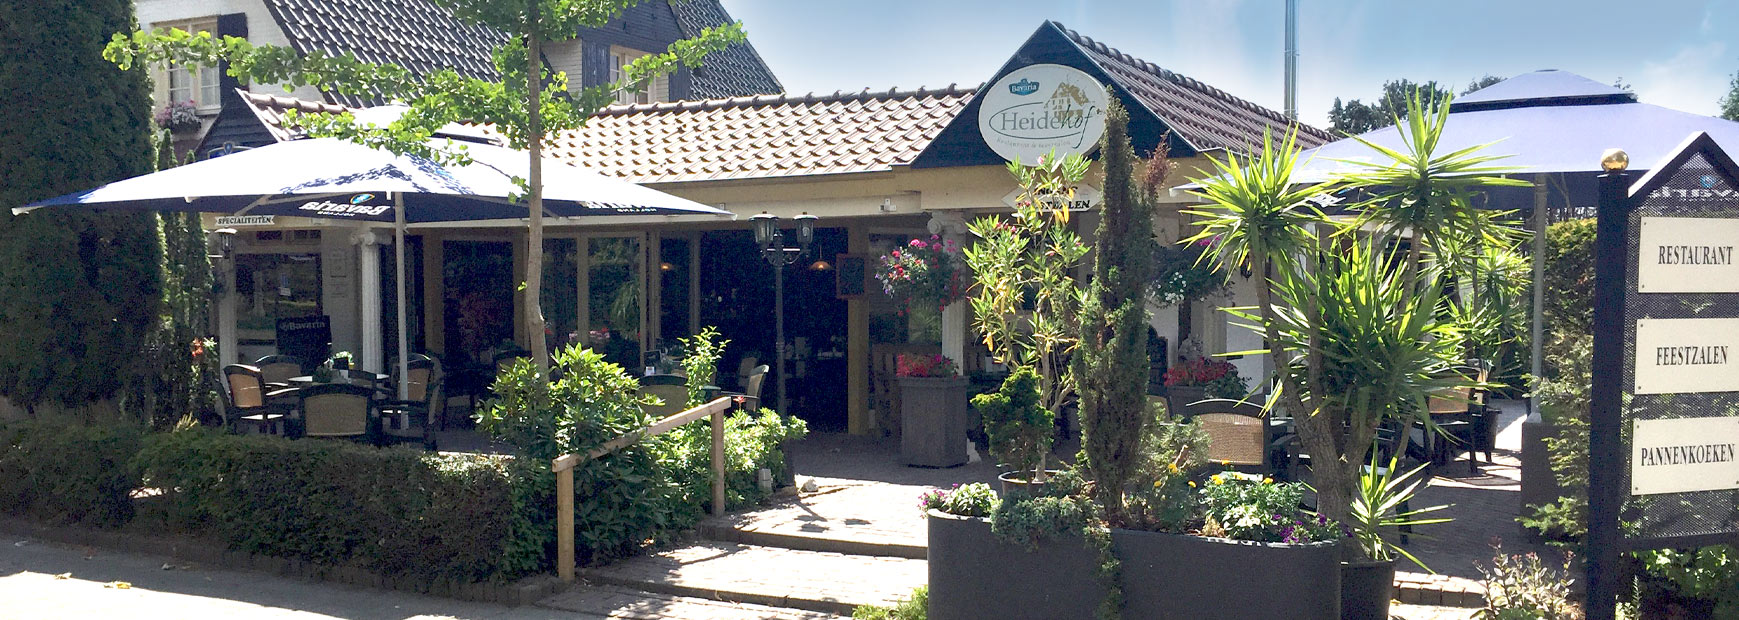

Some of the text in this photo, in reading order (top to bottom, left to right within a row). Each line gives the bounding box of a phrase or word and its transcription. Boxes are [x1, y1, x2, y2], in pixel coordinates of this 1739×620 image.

[1011, 84, 1037, 93] Bavaria
[1002, 104, 1095, 149] Heidehof
[217, 216, 272, 225] SPECIALITEITEN
[1658, 245, 1734, 265] RESTAURANT
[1656, 345, 1729, 366] FEESTZALEN
[1641, 443, 1735, 467] PANNENKOEKEN
